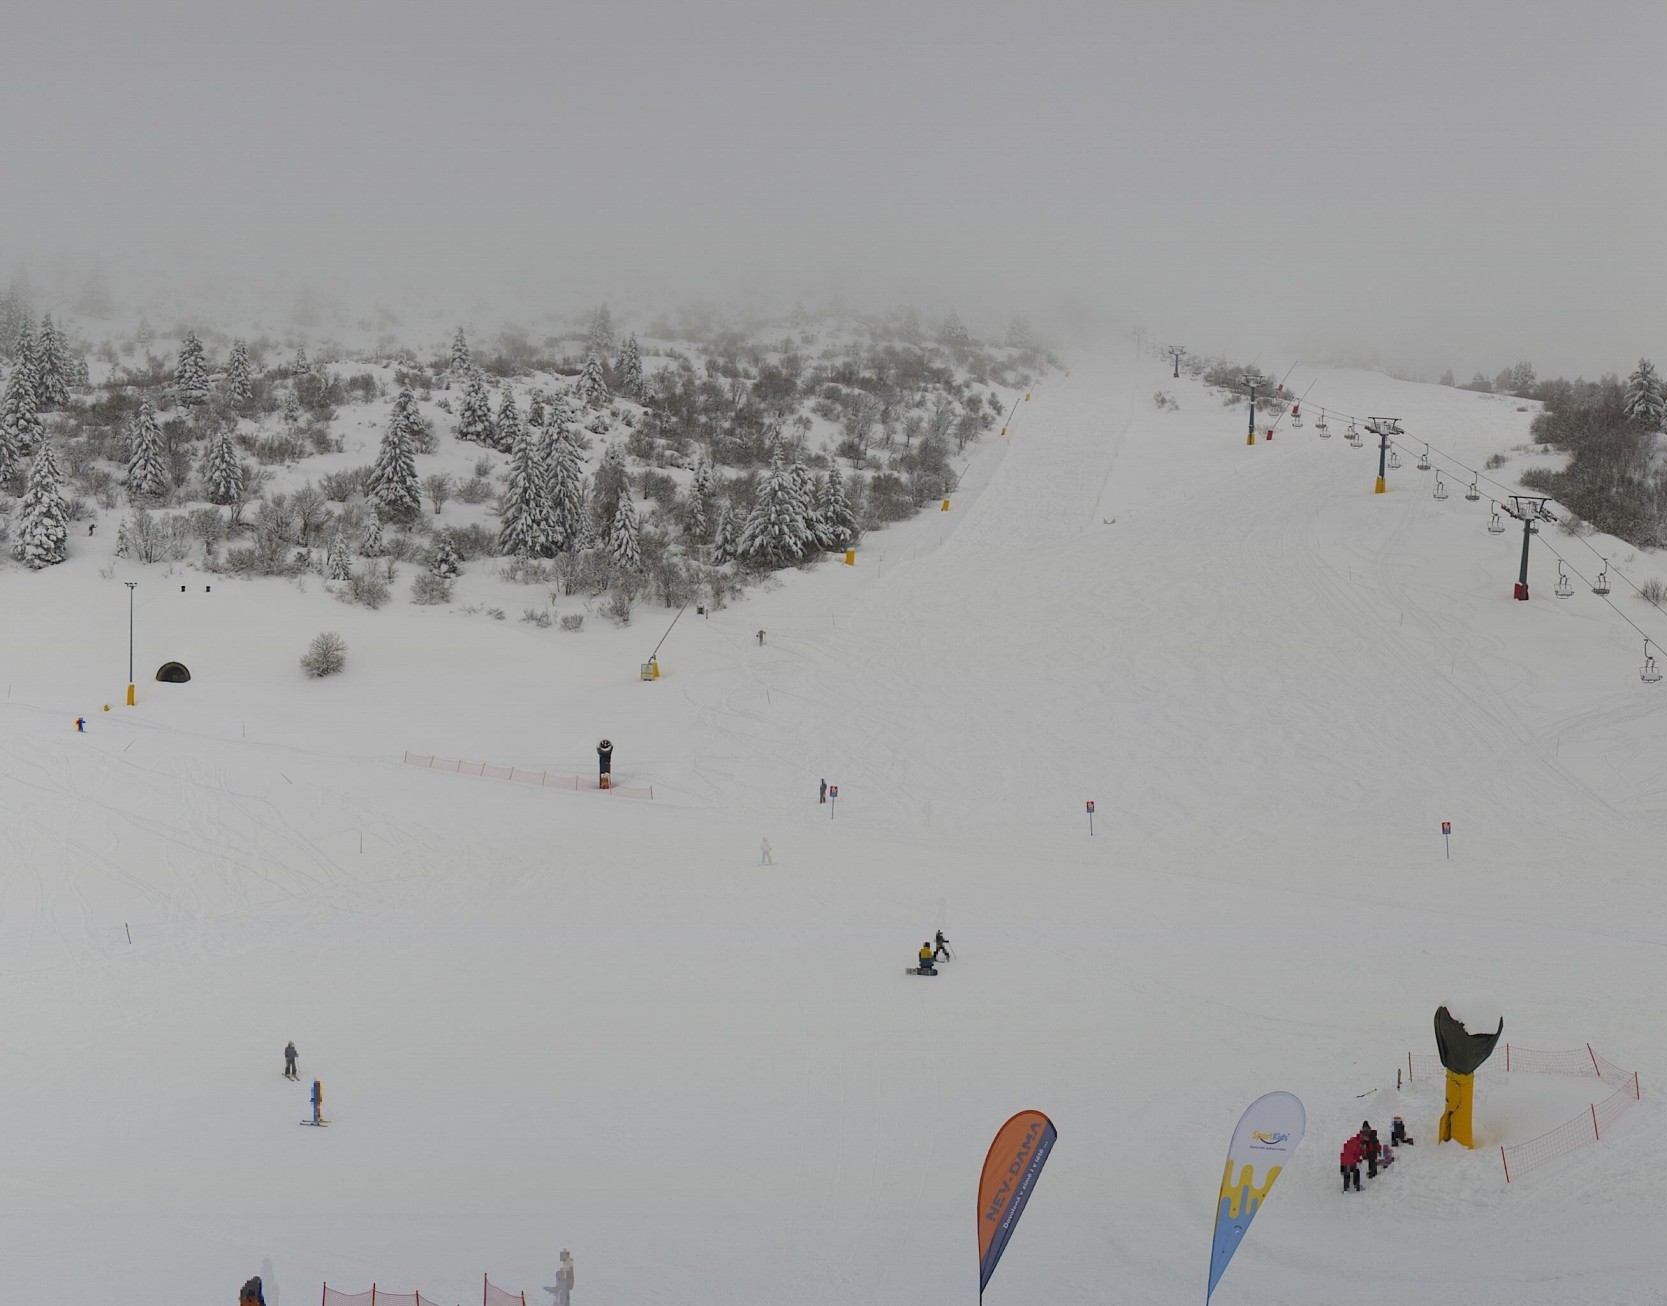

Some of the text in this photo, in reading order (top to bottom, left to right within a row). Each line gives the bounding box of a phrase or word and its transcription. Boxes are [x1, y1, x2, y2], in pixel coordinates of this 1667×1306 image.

[1252, 1130, 1289, 1141] SportKids
[985, 1121, 1042, 1222] NEV-DAMA
[1003, 1196, 1021, 1229] Dovolená
